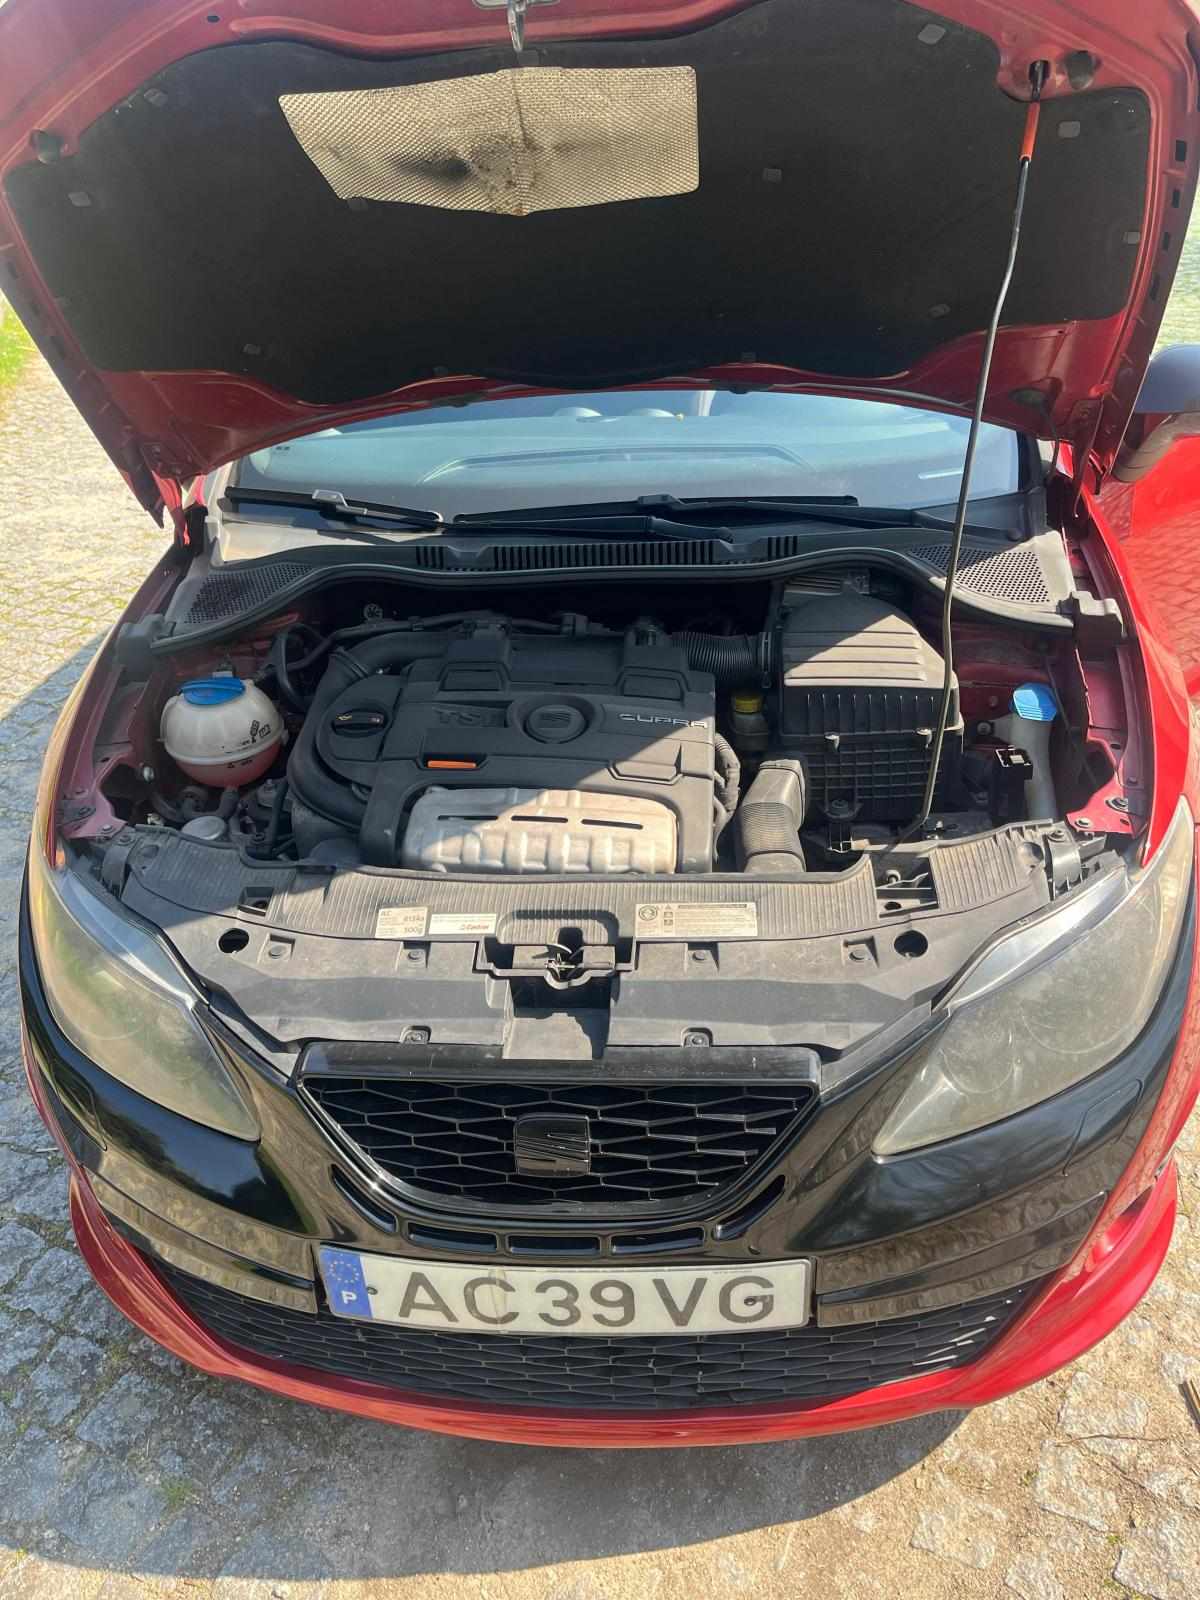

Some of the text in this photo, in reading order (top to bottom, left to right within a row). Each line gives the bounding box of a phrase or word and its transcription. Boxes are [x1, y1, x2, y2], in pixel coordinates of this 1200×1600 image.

[619, 713, 708, 729] CUPRA
[341, 1290, 358, 1305] P
[398, 1271, 775, 1328] AC 39 VG
